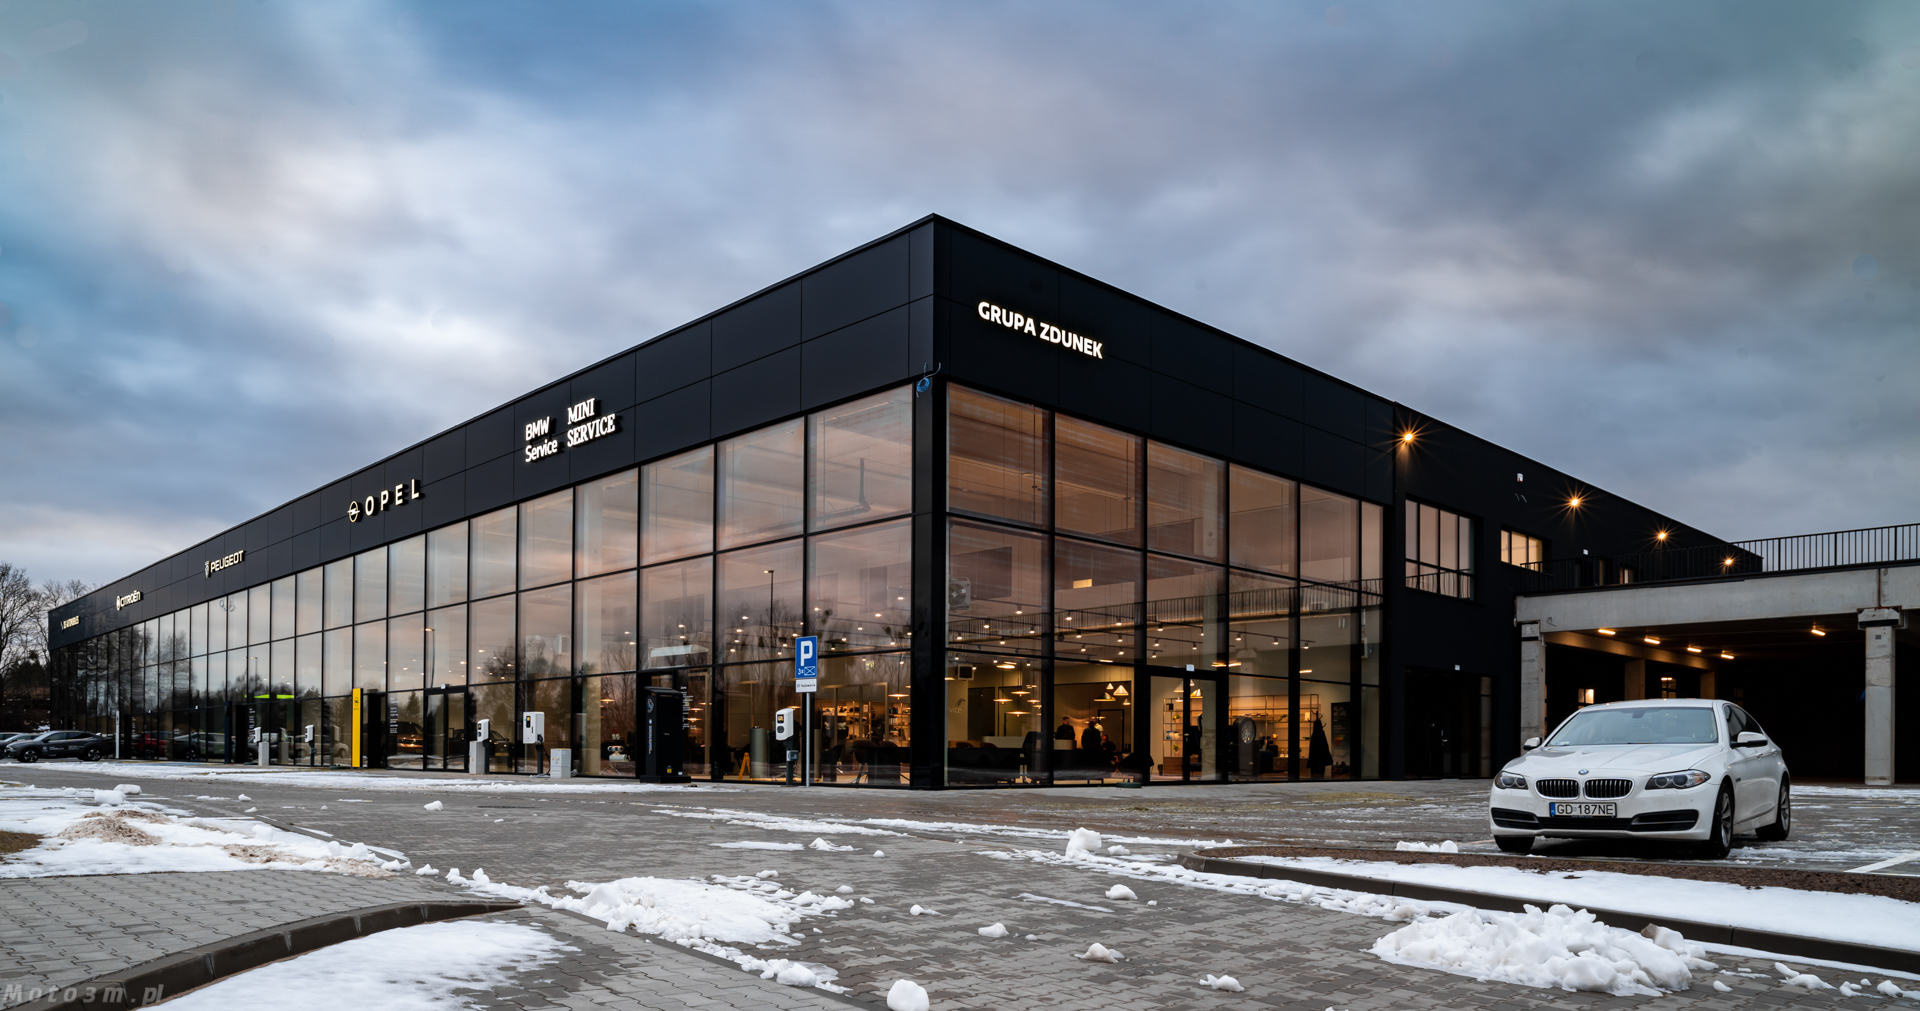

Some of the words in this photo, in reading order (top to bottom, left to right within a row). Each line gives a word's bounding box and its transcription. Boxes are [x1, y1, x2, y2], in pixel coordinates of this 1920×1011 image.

[977, 301, 1036, 337] GRUPA
[1039, 321, 1104, 359] ZDUNEK
[567, 398, 596, 425] MINI
[525, 416, 550, 442] BMW
[567, 413, 616, 448] SERVICE
[525, 439, 558, 463] Service
[365, 478, 420, 516] OPEL
[210, 550, 244, 572] PEUGEOT
[801, 640, 813, 667] P
[1556, 804, 1573, 814] GD
[1578, 804, 1614, 814] 187NE
